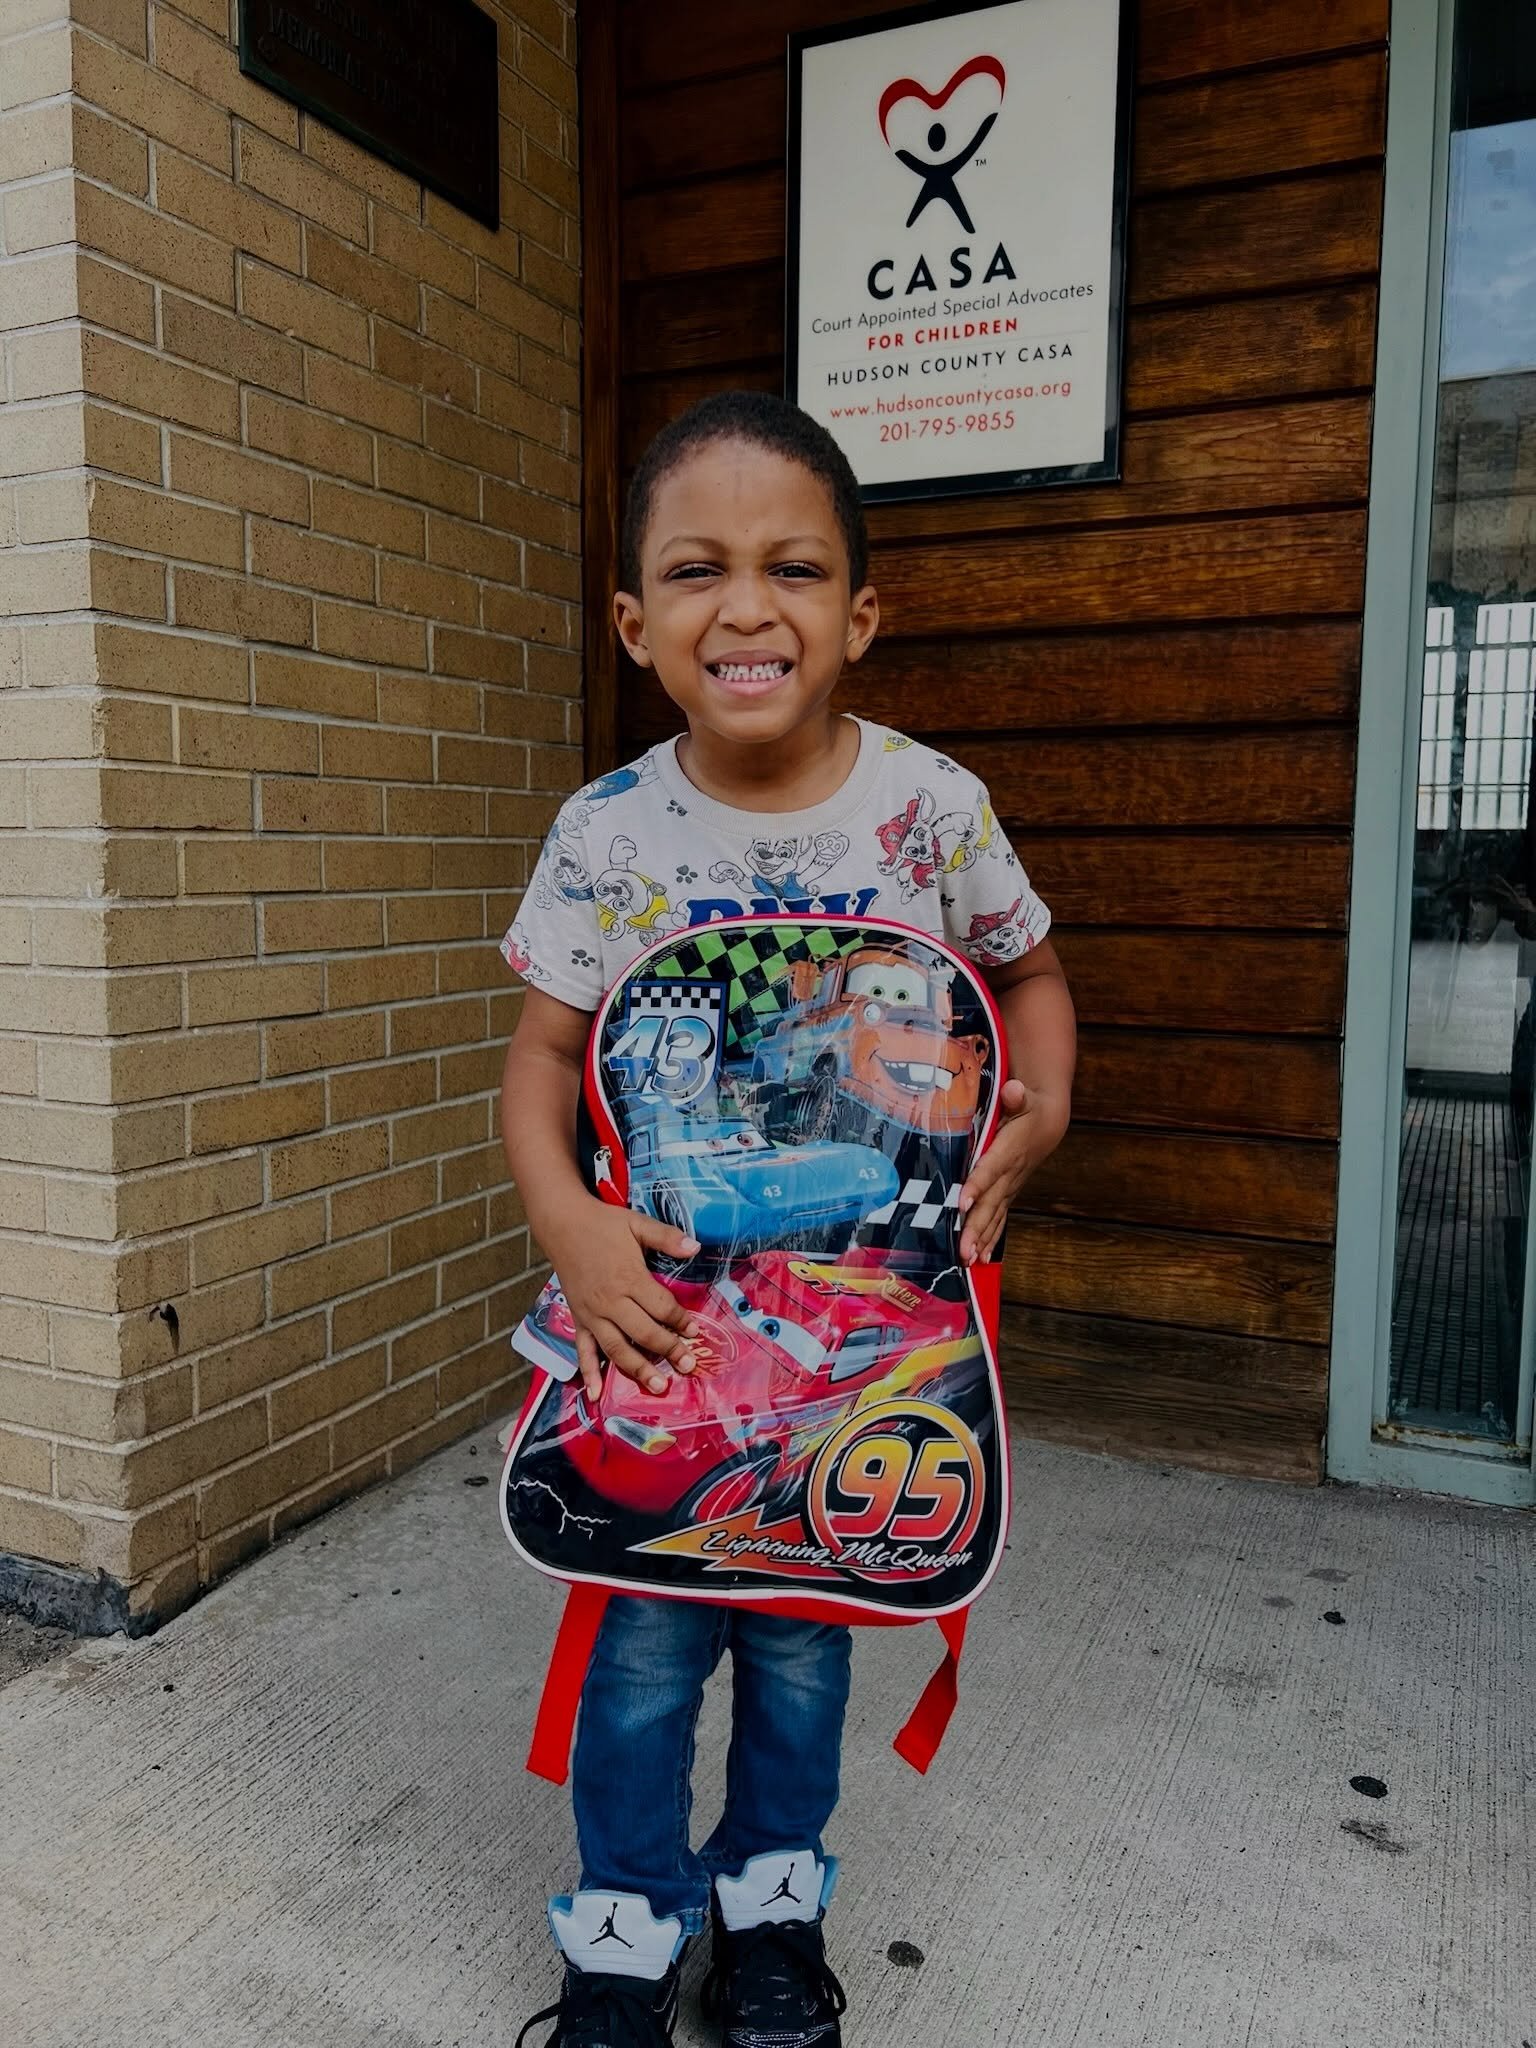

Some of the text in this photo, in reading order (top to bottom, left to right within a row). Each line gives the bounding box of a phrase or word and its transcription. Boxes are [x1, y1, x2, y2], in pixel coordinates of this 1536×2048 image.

[867, 242, 1017, 300] CASA
[812, 283, 1094, 334] Court Appointed Special Advocates
[868, 318, 1018, 351] FOR CHILDREN
[828, 344, 1073, 386] HUDSON COUNTY CASA
[830, 381, 1071, 418] www.hudsoncountycasa.org
[880, 411, 1015, 442] 201-795-9855
[608, 1015, 715, 1099] 43
[763, 1184, 782, 1199] 43
[858, 1167, 879, 1180] 43
[830, 1437, 968, 1540] 95
[702, 1531, 973, 1572] Lightning McQueen
